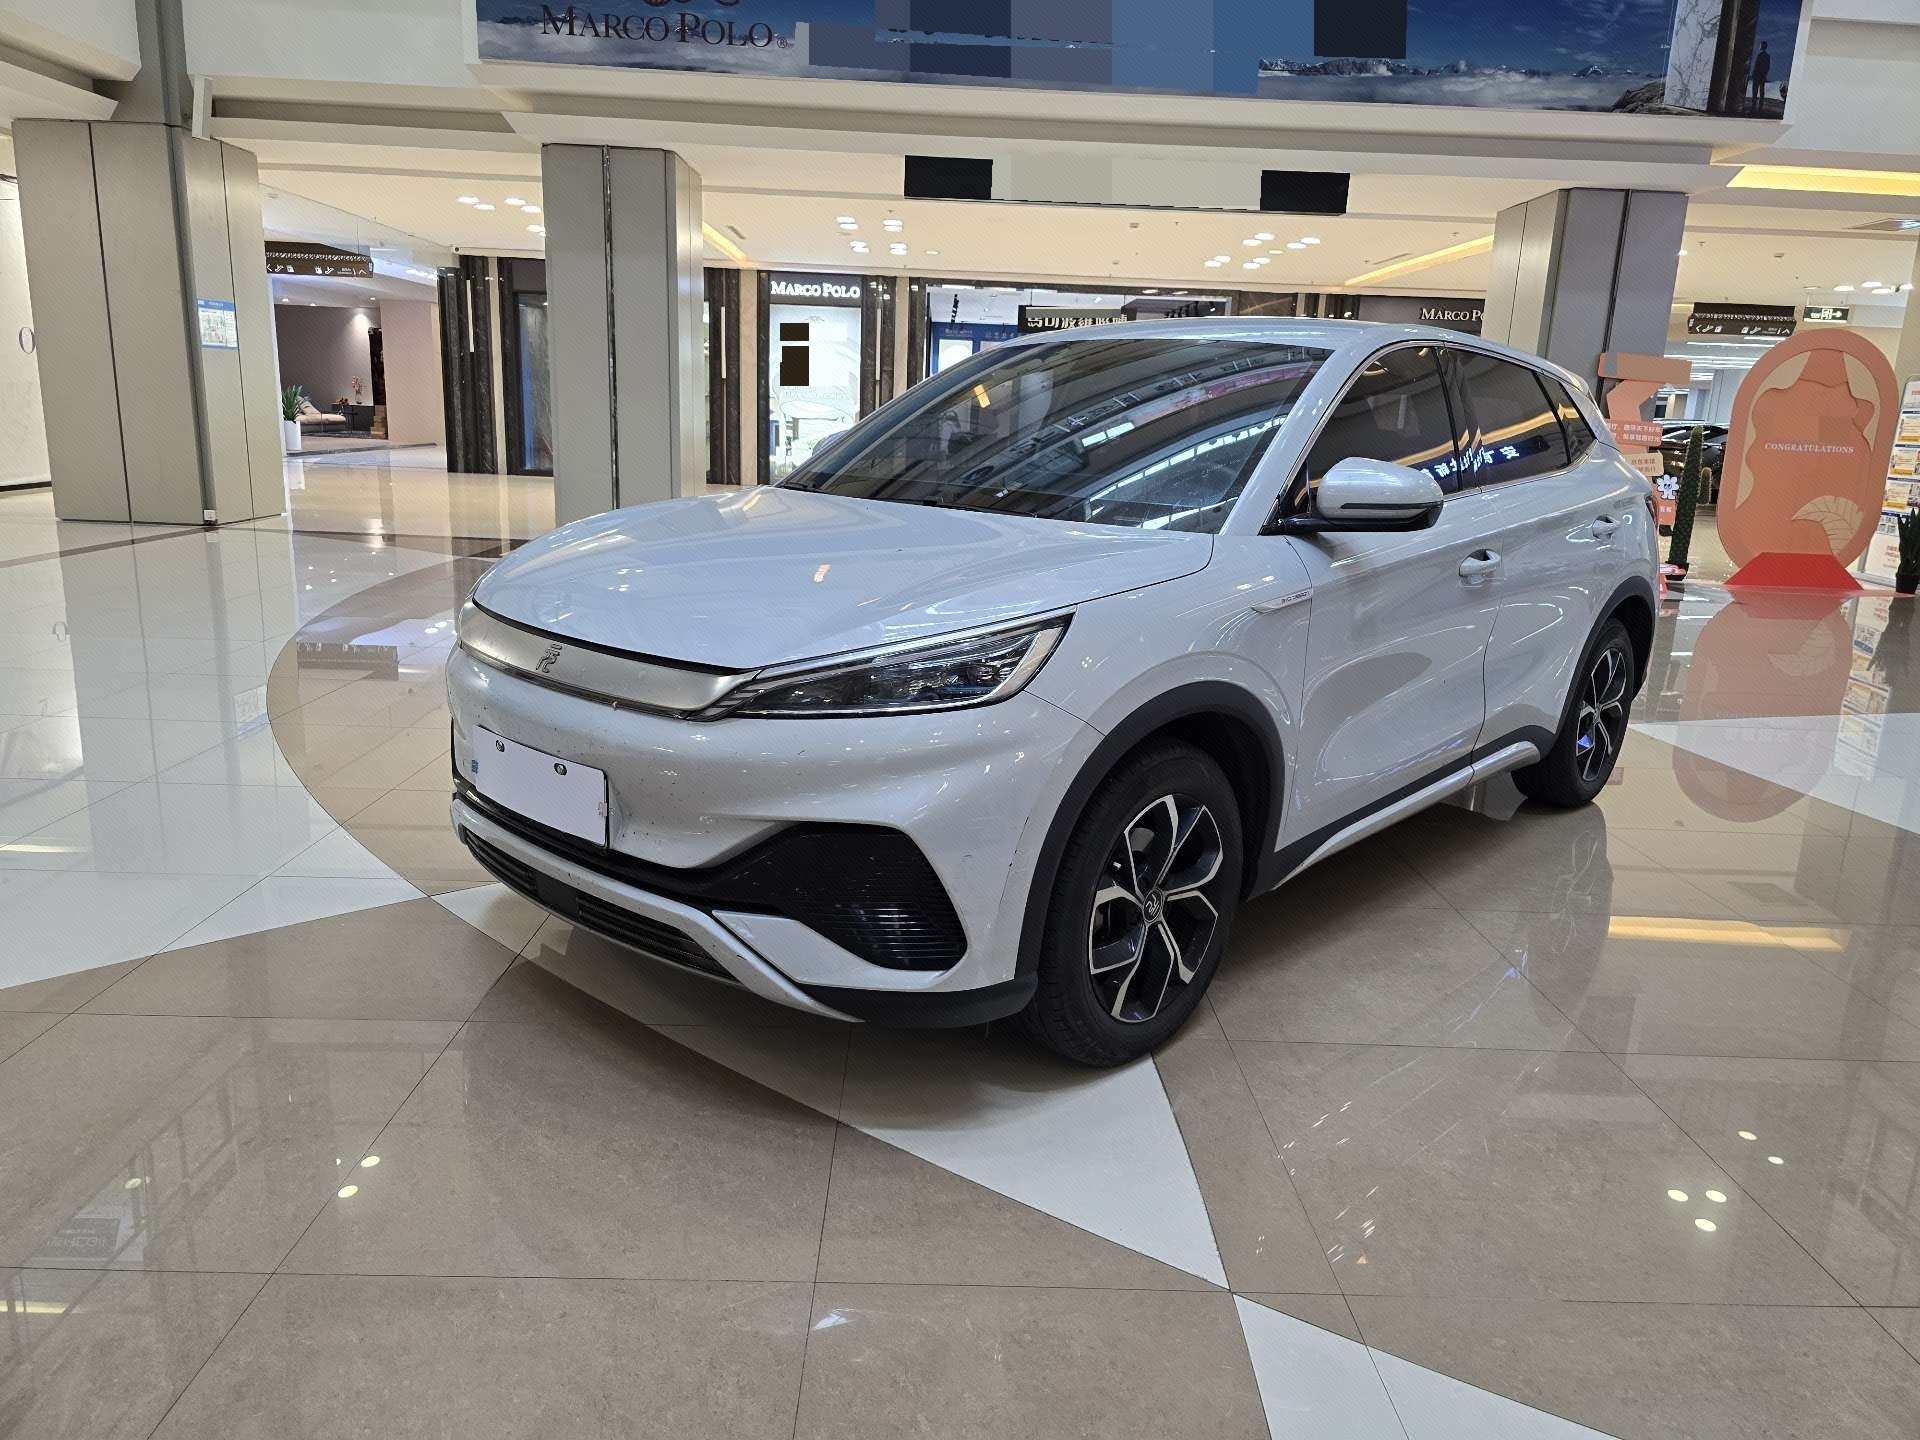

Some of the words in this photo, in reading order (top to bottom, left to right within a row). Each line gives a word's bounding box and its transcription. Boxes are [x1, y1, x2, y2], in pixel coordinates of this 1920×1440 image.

[540, 4, 670, 42] MARCO
[677, 12, 774, 48] POLO
[770, 281, 821, 297] MARCO
[822, 282, 861, 298] POLO
[1421, 307, 1470, 321] MARCO
[1764, 442, 1855, 454] CONGRATULATIONS
